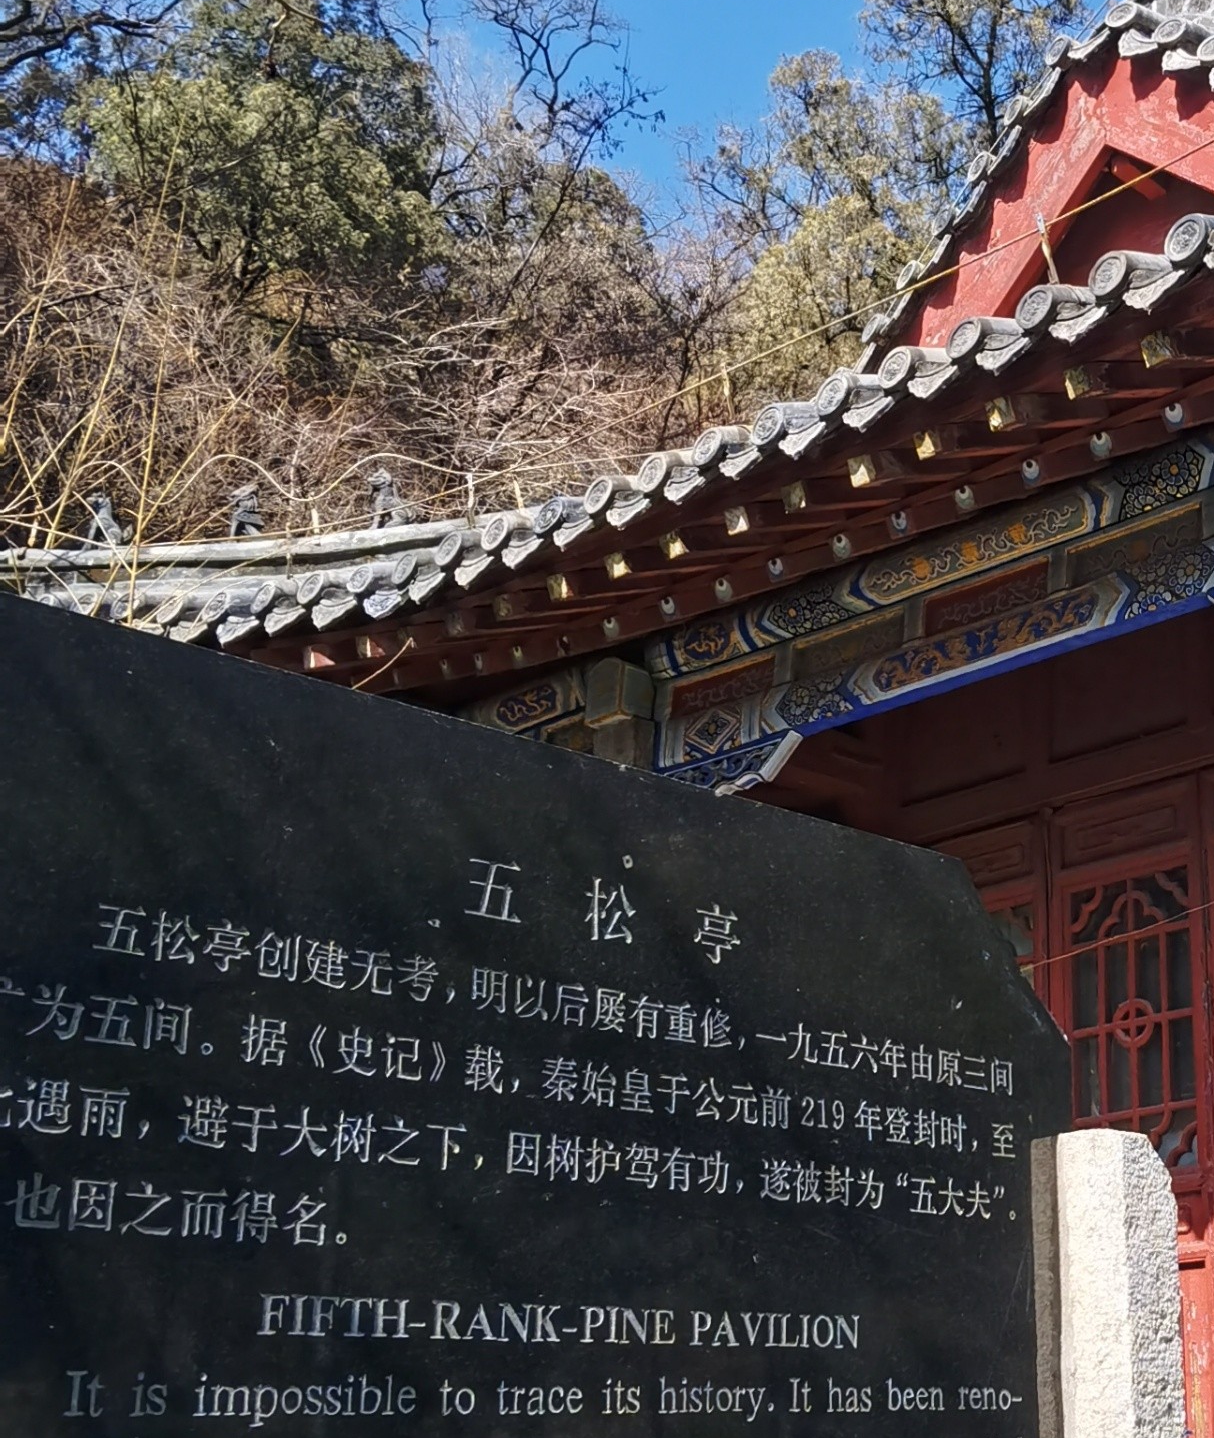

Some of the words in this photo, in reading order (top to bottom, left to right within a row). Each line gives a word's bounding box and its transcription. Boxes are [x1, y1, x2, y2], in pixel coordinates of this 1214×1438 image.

[463, 857, 741, 965] 五松亭
[4, 1171, 347, 1247] 也因之而得名。
[256, 1292, 675, 1346] FIFTH-RANK-PINE
[689, 1311, 860, 1349] PAVILION
[63, 1370, 104, 1419] It
[130, 1372, 168, 1418] is
[193, 1373, 417, 1428] impossible
[440, 1379, 476, 1416] to
[498, 1380, 584, 1416] trace
[601, 1377, 641, 1415] its
[658, 1376, 776, 1422] history.
[789, 1377, 812, 1413] It
[827, 1377, 873, 1413] has
[886, 1378, 945, 1412] been
[957, 1386, 1023, 1412] reno-
